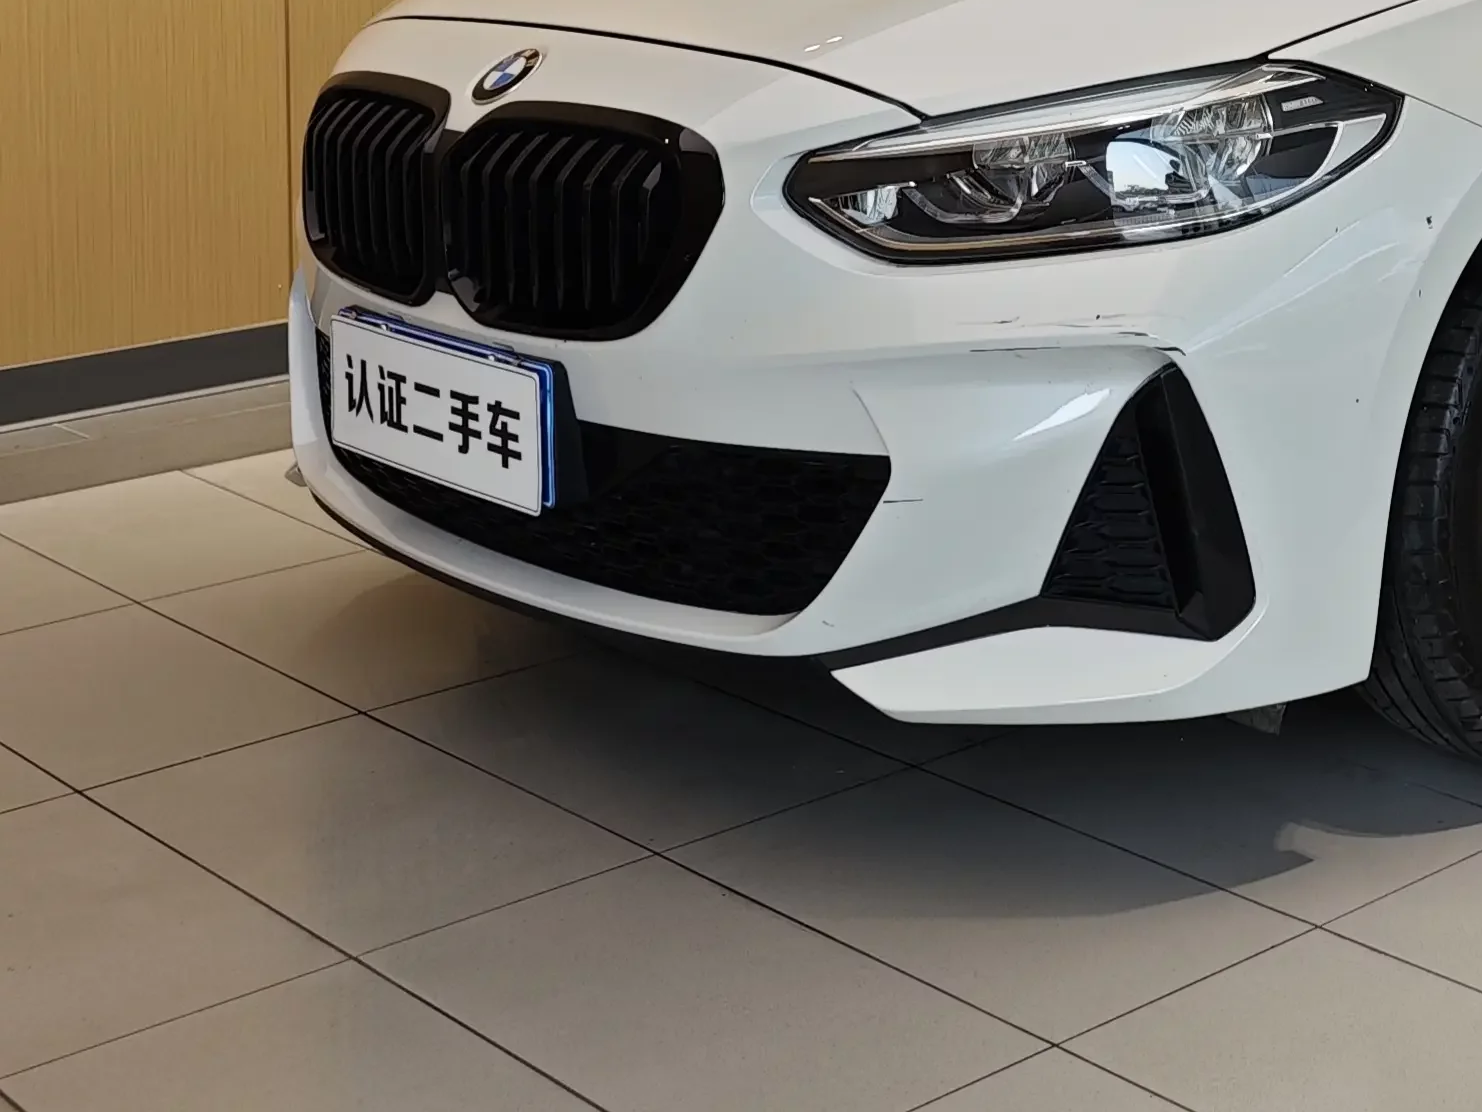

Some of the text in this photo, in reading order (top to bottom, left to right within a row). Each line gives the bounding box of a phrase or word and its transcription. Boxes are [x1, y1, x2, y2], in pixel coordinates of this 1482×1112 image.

[345, 354, 522, 469] 认证二手车
